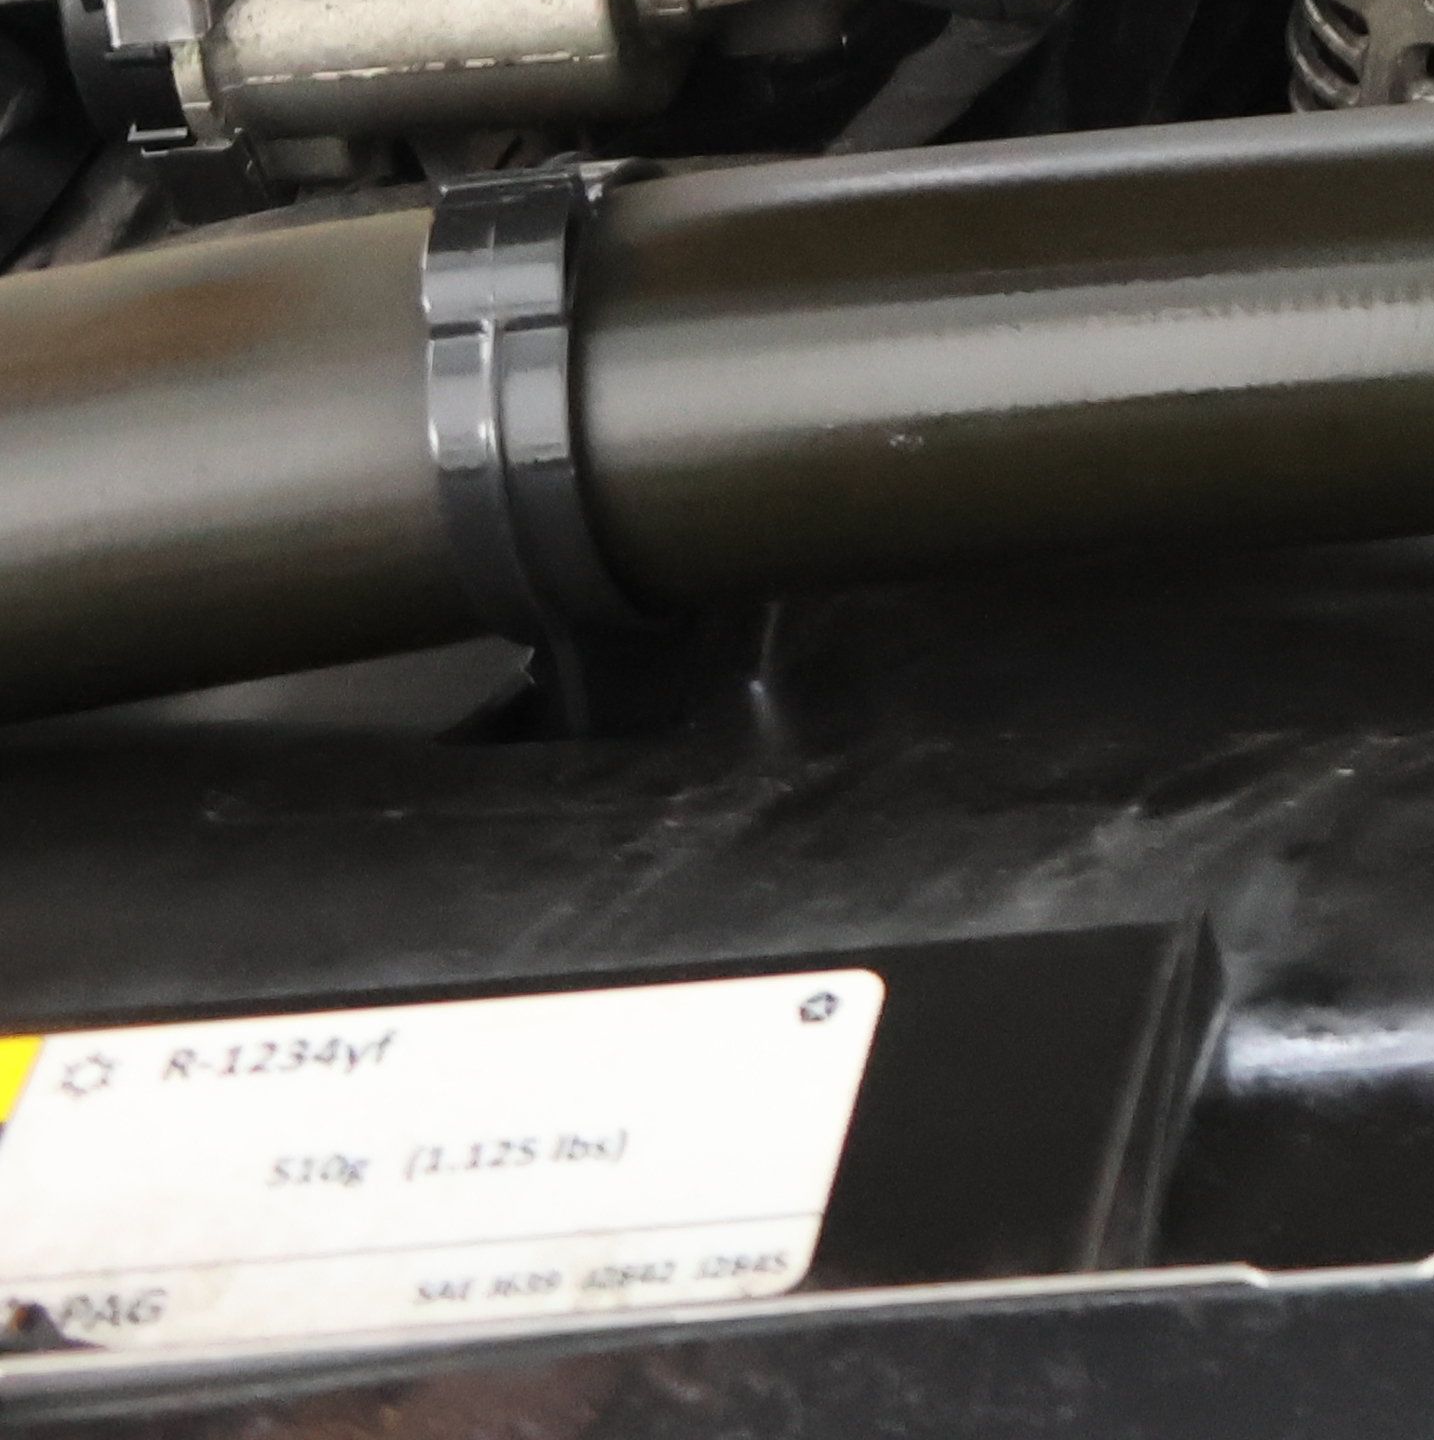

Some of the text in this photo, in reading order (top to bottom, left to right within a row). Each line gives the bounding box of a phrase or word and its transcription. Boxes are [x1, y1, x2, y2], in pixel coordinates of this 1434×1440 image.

[162, 1029, 397, 1081] R-1234yf
[267, 1154, 370, 1189] 510g
[551, 1128, 629, 1167] lbs)
